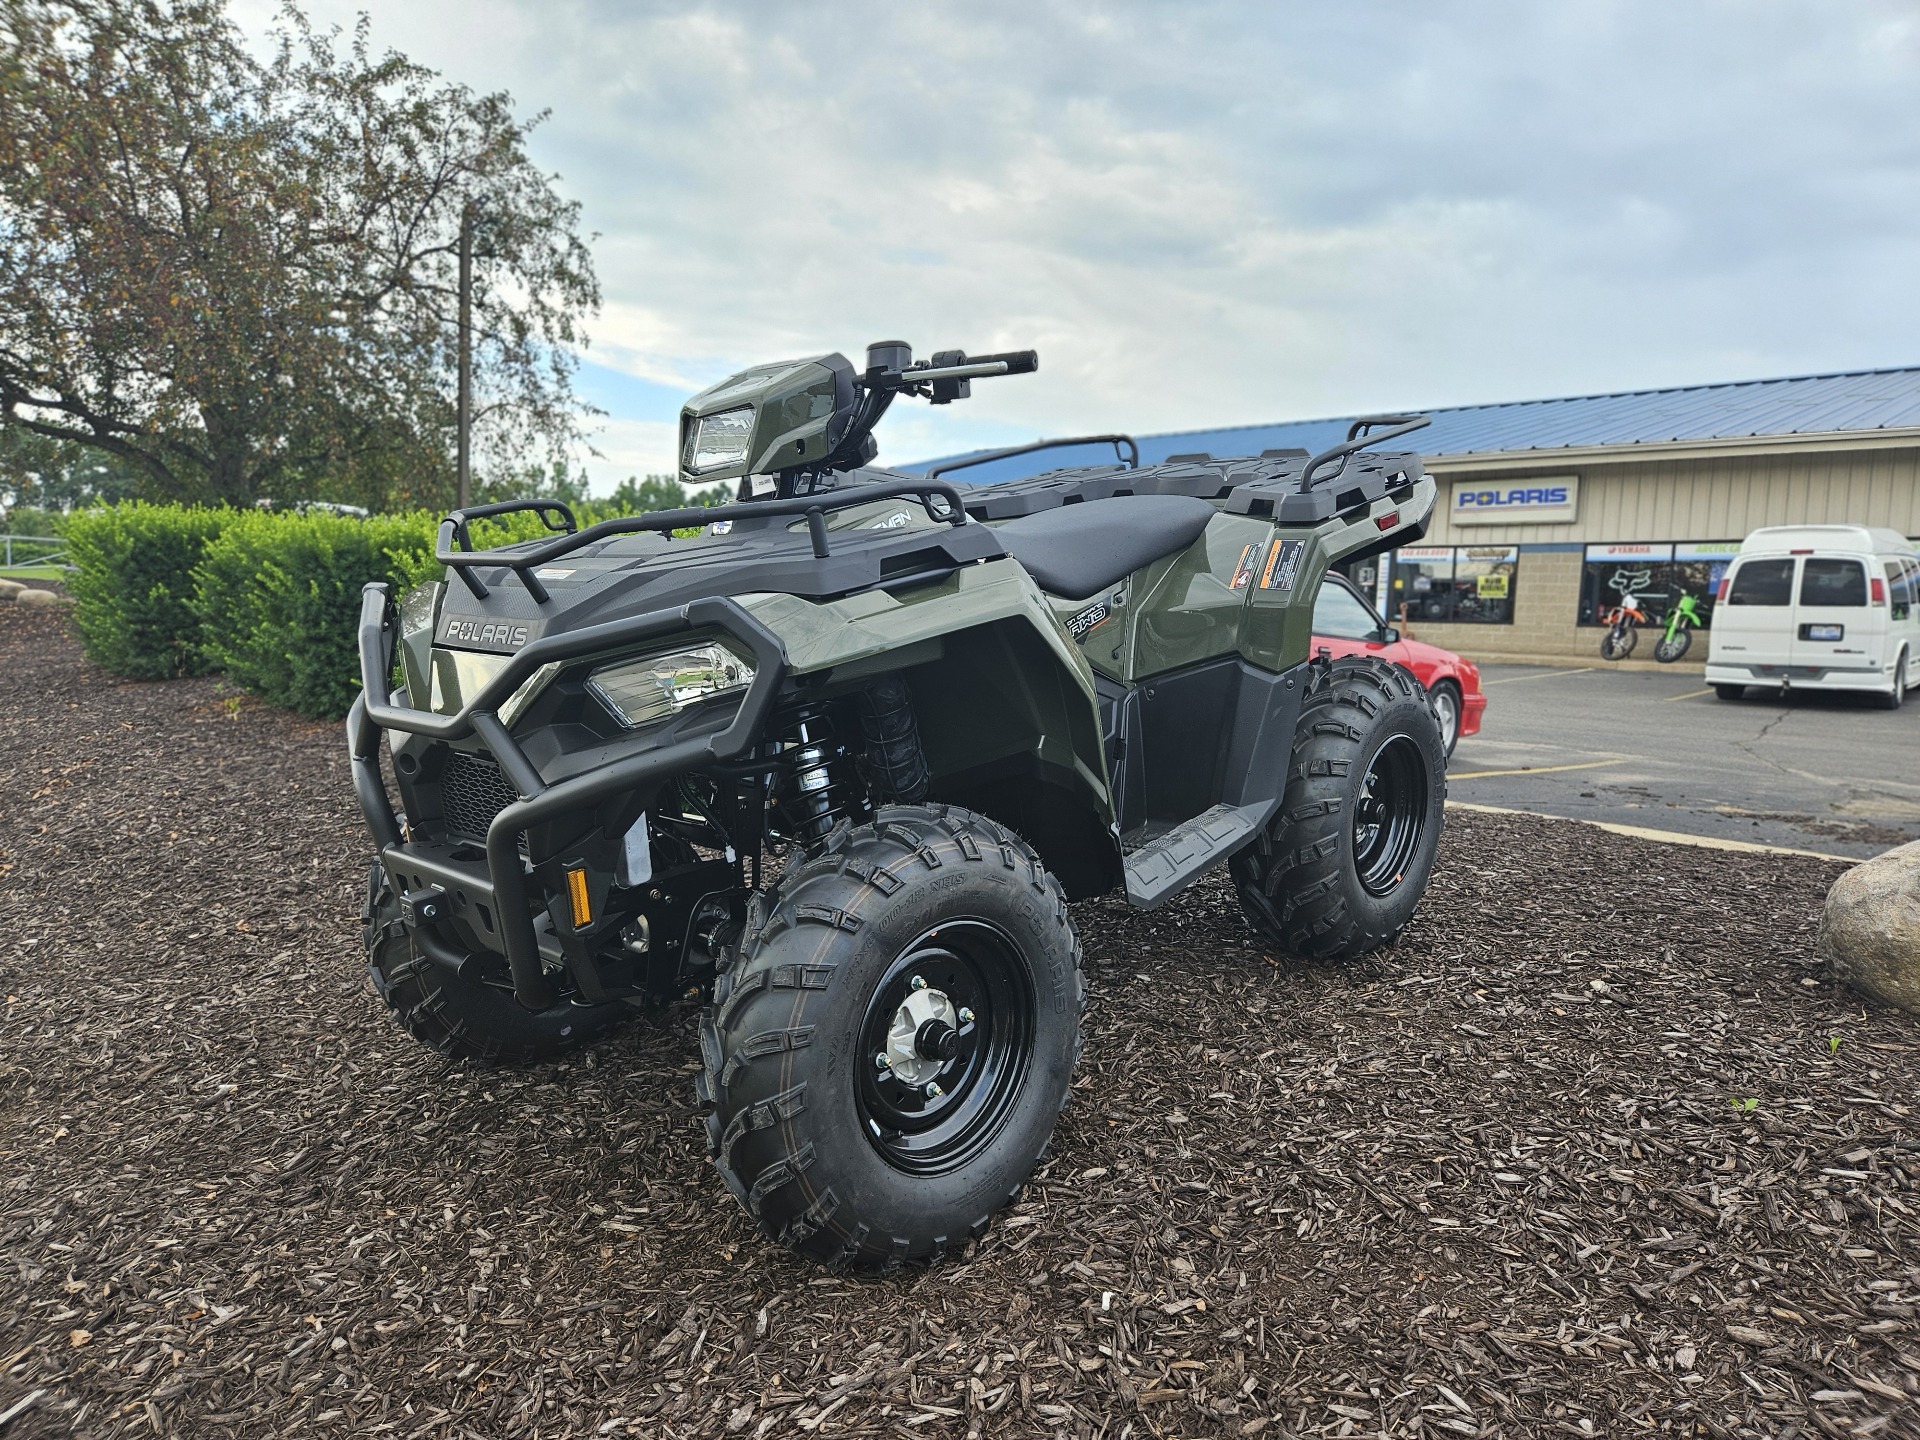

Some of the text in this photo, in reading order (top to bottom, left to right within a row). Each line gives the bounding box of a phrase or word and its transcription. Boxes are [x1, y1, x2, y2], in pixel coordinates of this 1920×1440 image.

[1459, 487, 1568, 507] POLARIS
[1617, 545, 1651, 554] YAMAHA
[446, 621, 528, 646] POLARIS
[1069, 607, 1106, 637] AWD
[929, 871, 967, 895] NHS
[1017, 900, 1067, 1015] POLARIS
